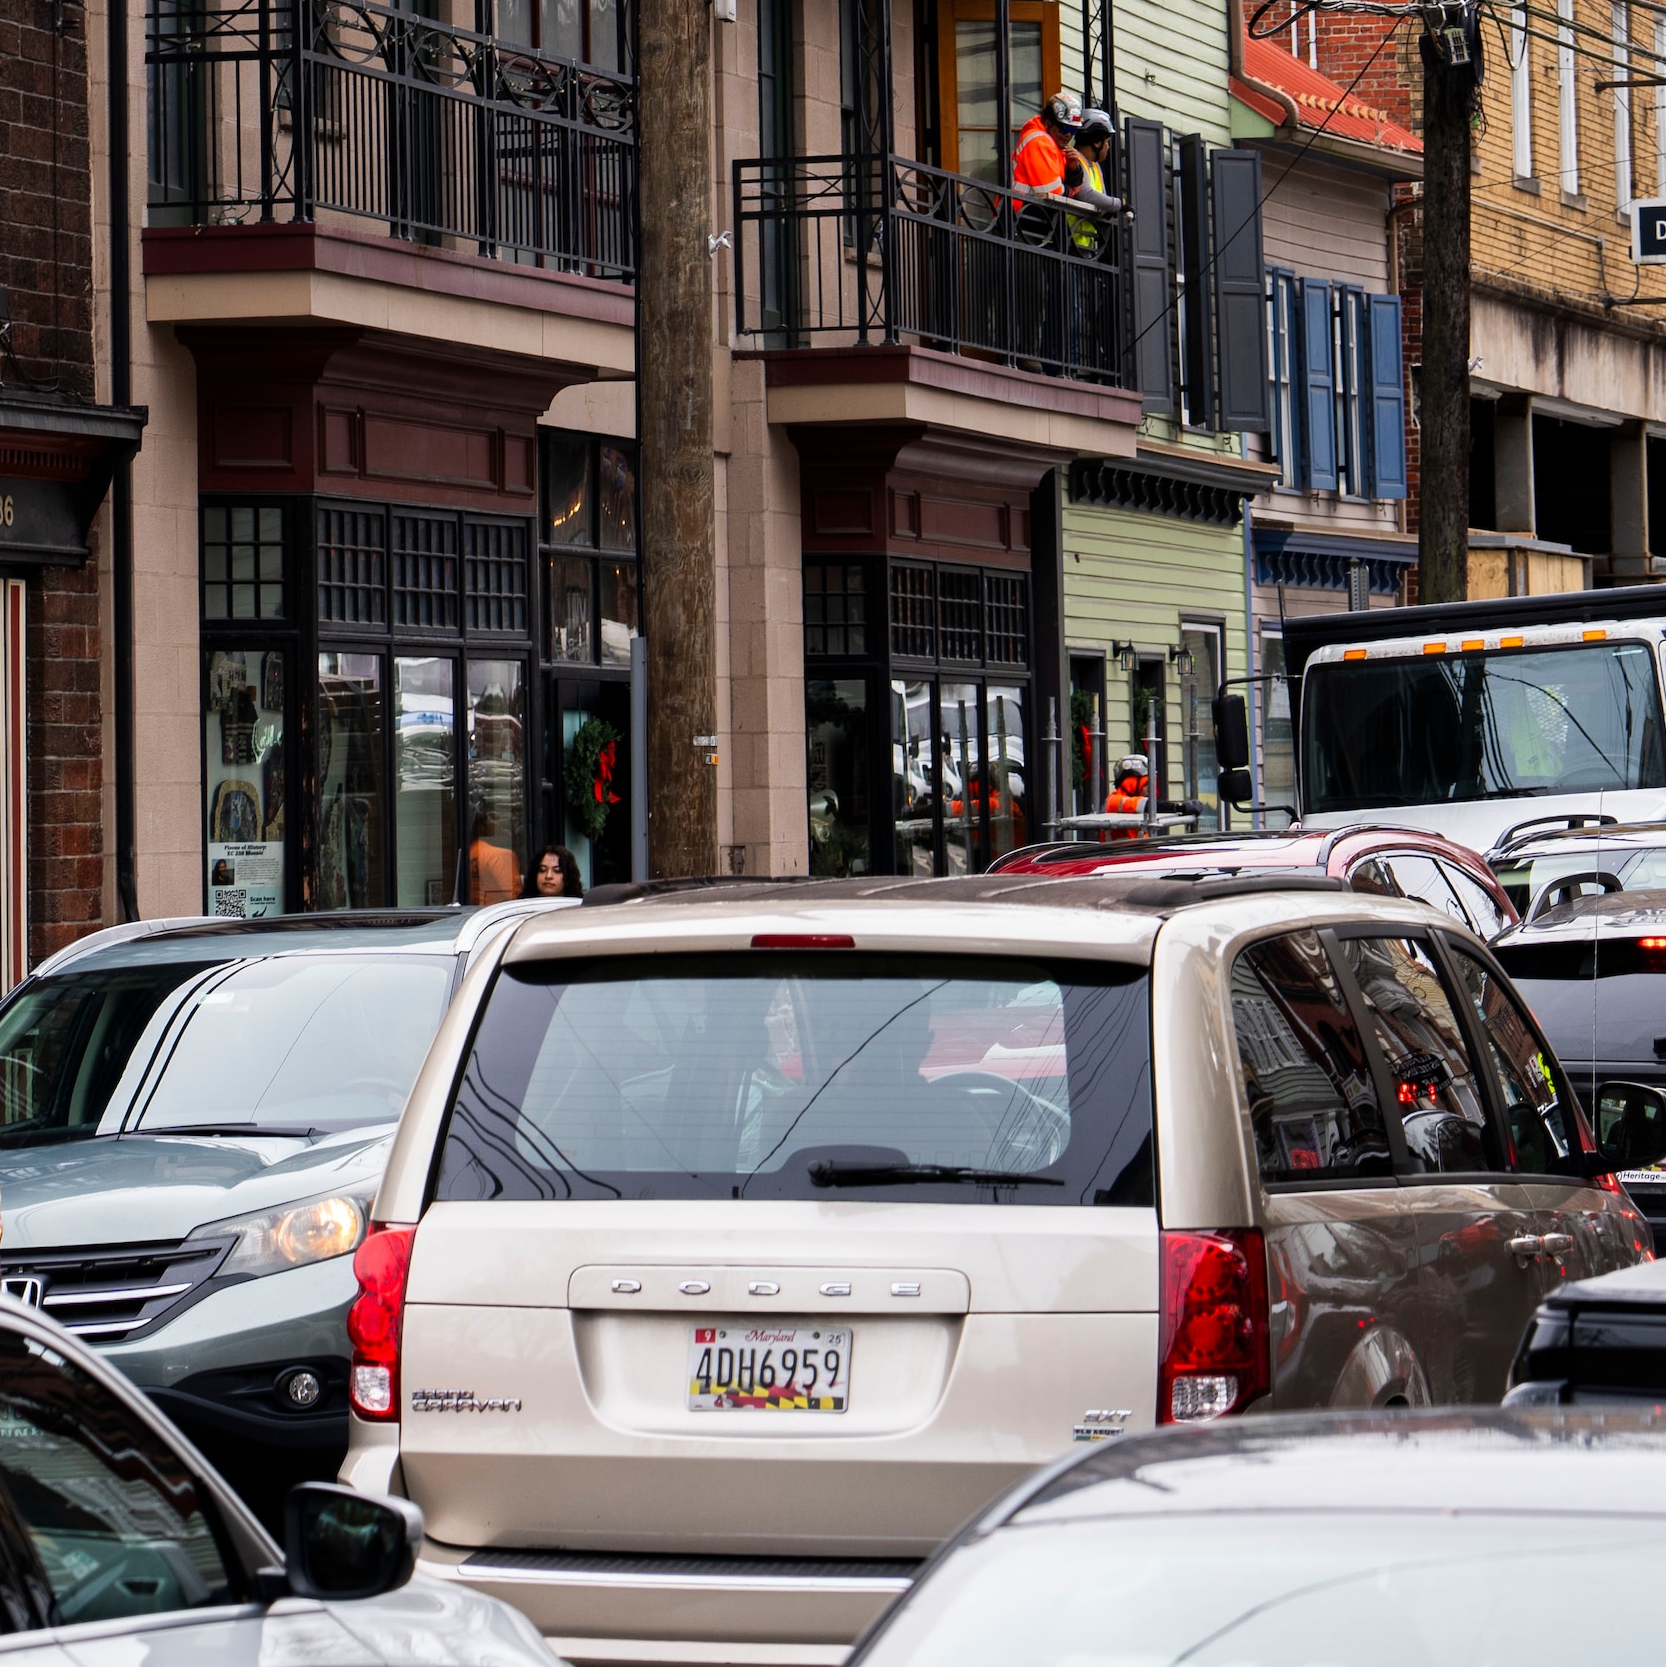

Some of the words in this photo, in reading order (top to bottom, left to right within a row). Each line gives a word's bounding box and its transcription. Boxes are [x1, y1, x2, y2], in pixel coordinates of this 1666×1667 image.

[1623, 1172, 1661, 1182] Heritage
[611, 1278, 922, 1297] DODGE
[704, 1331, 712, 1341] 9
[745, 1329, 797, 1347] Maryland
[828, 1334, 842, 1344] 25
[696, 1347, 842, 1389] 4DH6959
[412, 1389, 474, 1400] GRAND
[412, 1399, 522, 1413] CARAVAN
[1084, 1409, 1132, 1423] SXT
